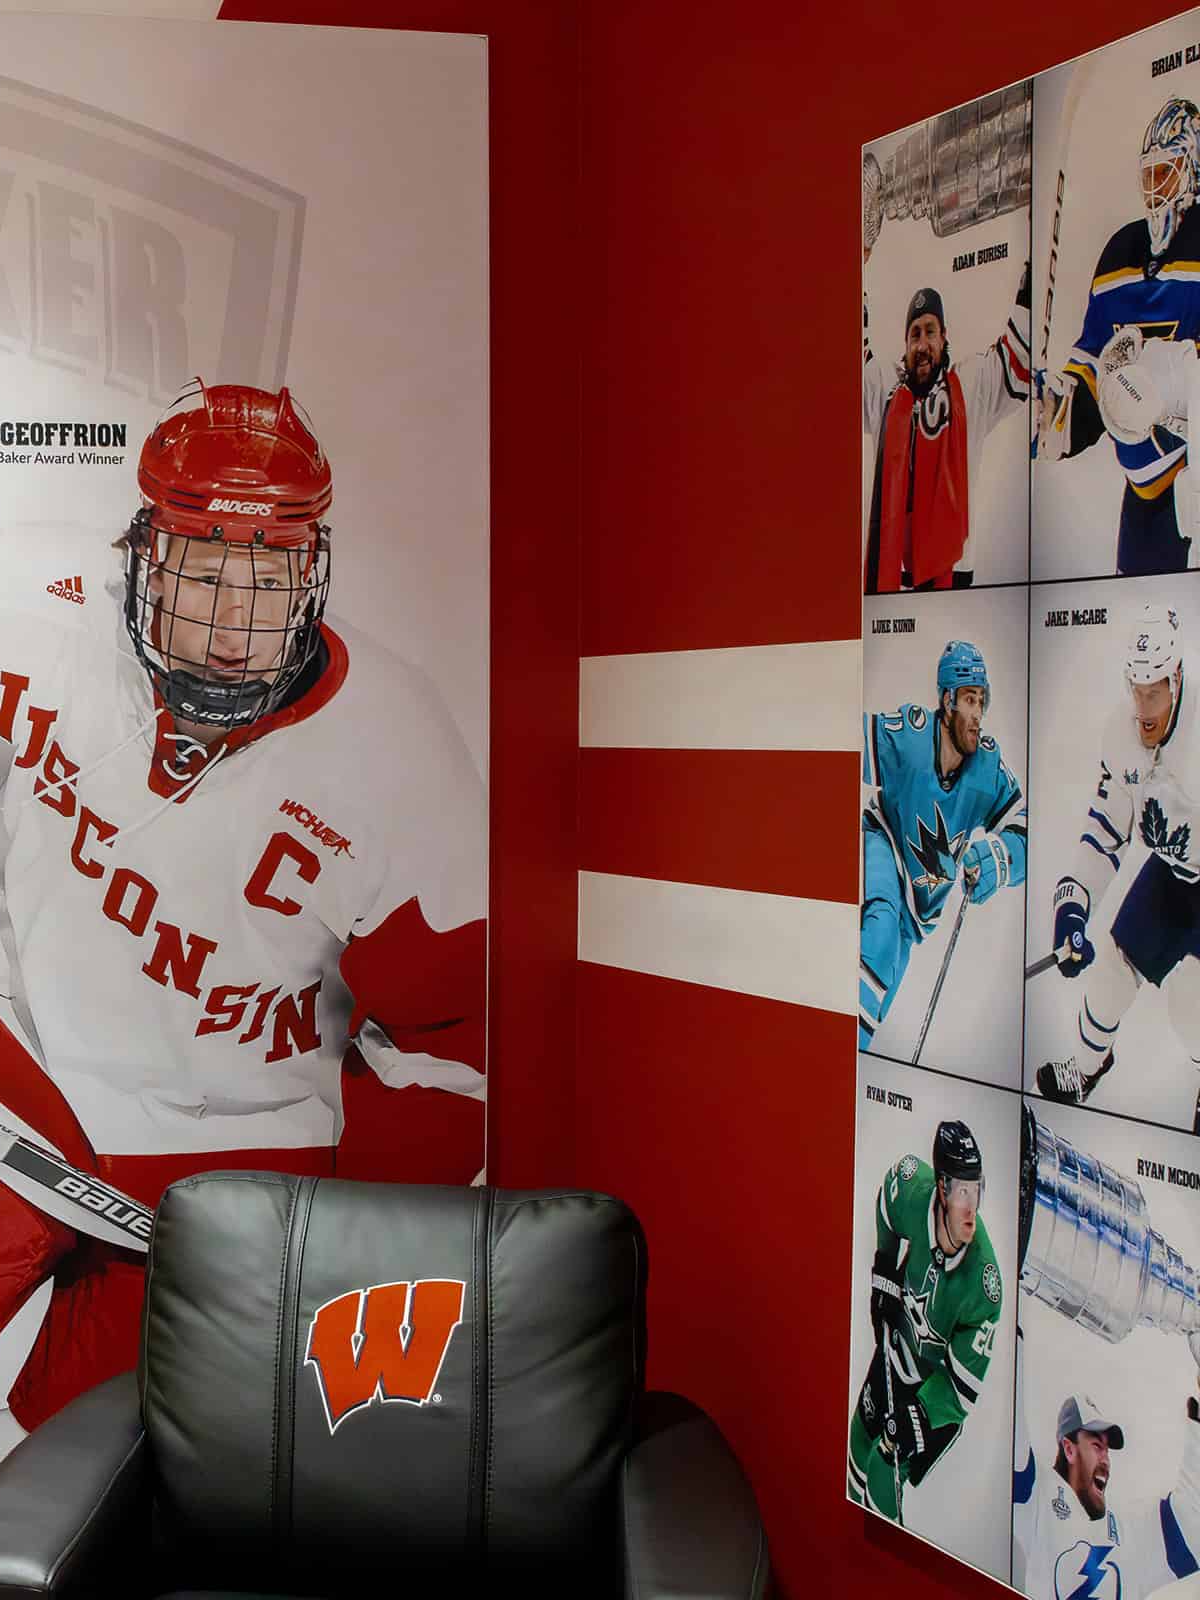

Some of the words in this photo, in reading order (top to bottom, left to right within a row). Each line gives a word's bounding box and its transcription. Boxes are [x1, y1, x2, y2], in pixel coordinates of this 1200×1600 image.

[1152, 50, 1182, 78] BRIAN
[1185, 43, 1200, 64] EL
[952, 251, 975, 272] ADAM
[977, 242, 1008, 265] BURISH
[0, 421, 127, 447] GEOFFRION
[34, 452, 75, 465] Award
[78, 452, 125, 465] Winner
[207, 498, 275, 517] BADGERS
[46, 584, 86, 605] adidas
[872, 619, 892, 634] LUKE
[1045, 610, 1069, 627] JAKE
[1071, 608, 1107, 626] McCABE
[243, 831, 322, 917] C
[866, 1085, 886, 1104] RYAN
[888, 1091, 912, 1112] SUTER
[1137, 1158, 1165, 1181] RYAN
[53, 1177, 153, 1238] BAUE
[303, 1278, 467, 1436] W
